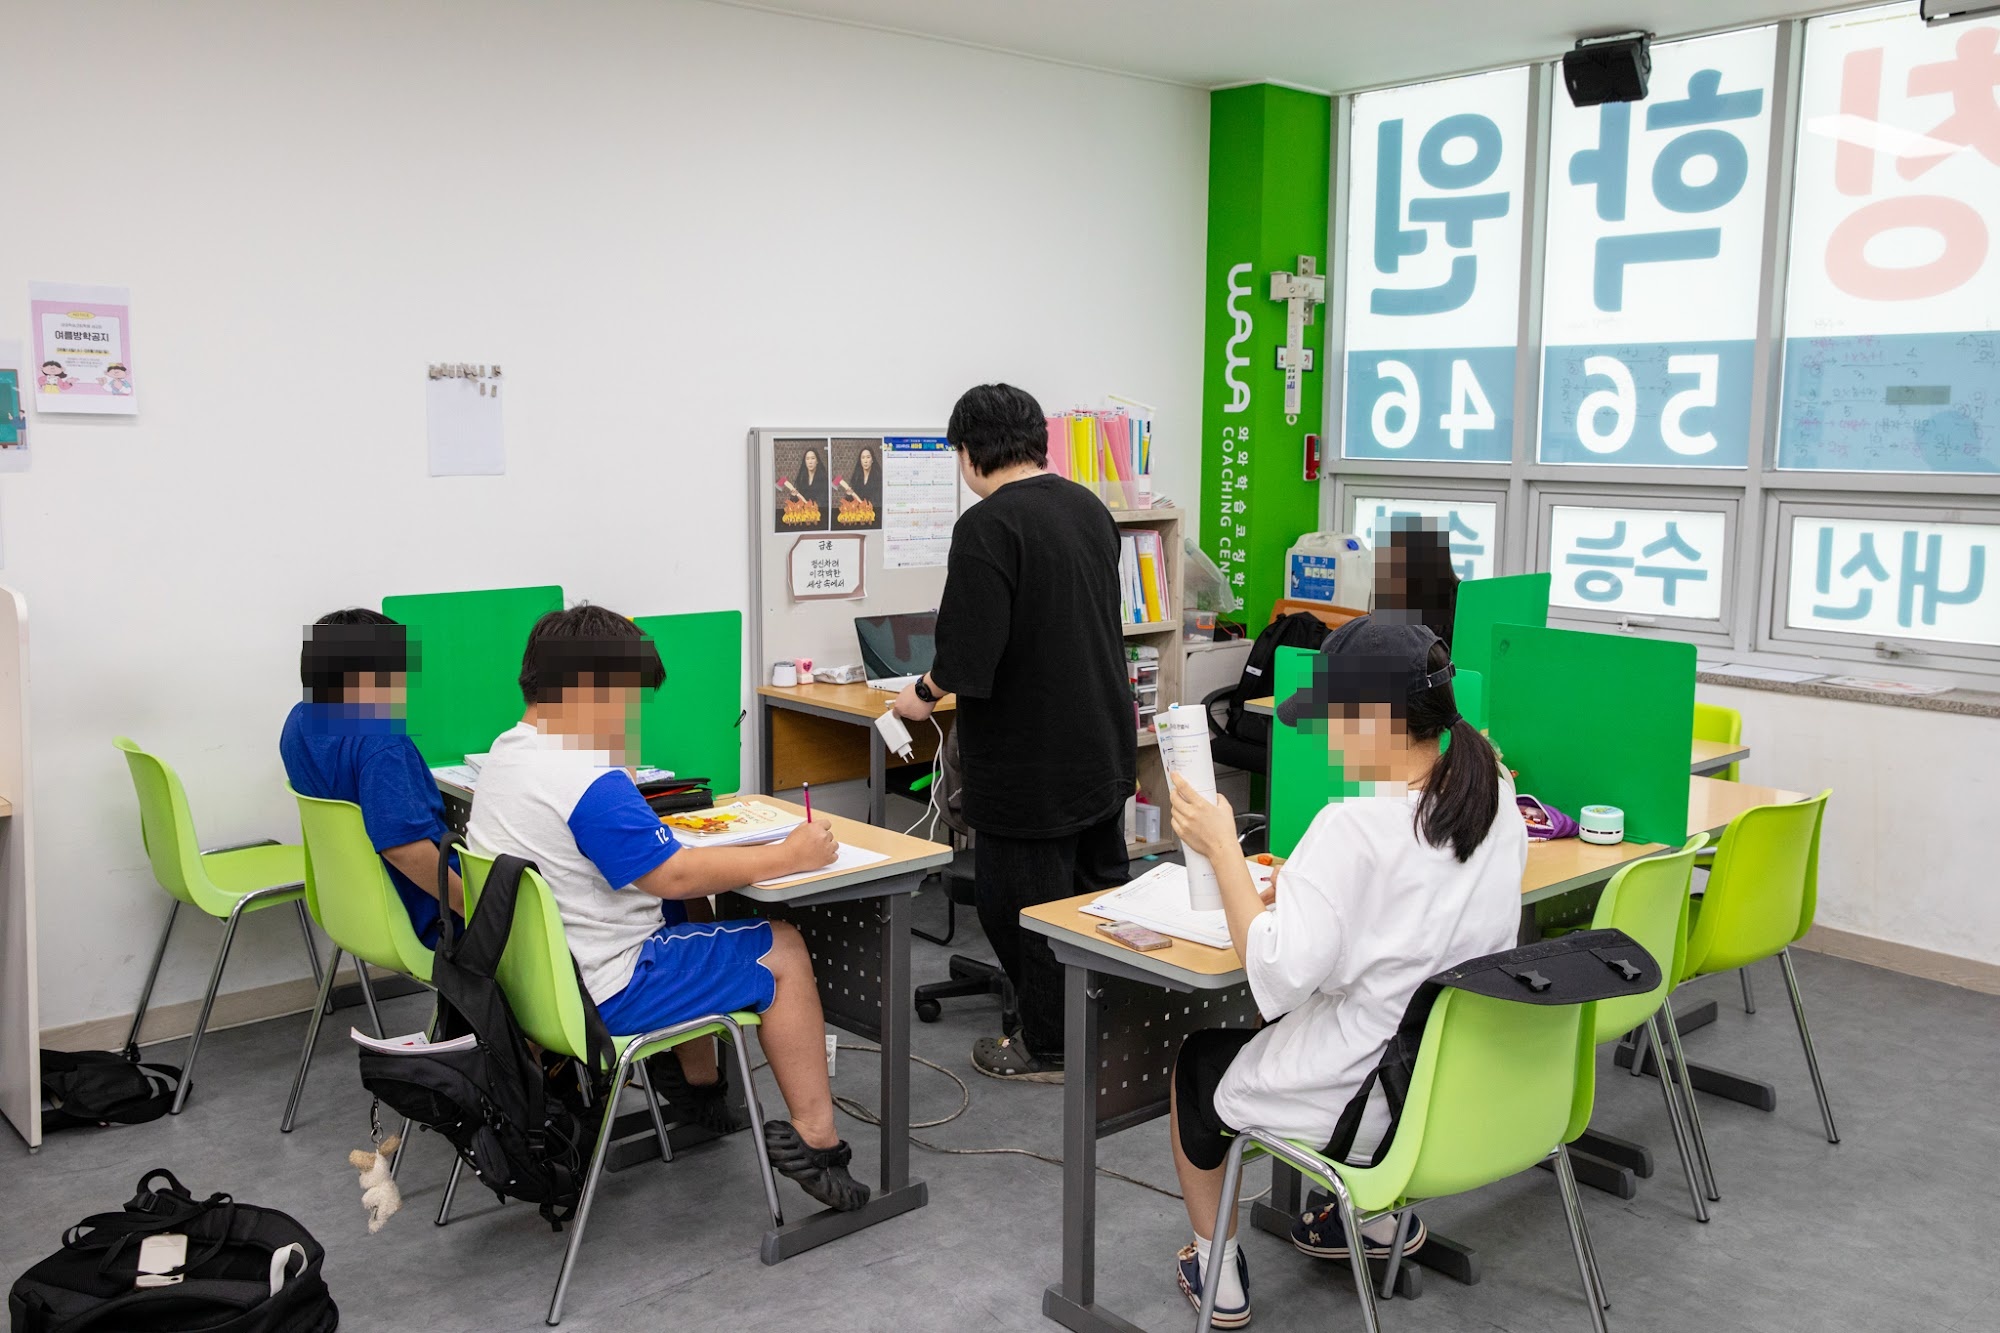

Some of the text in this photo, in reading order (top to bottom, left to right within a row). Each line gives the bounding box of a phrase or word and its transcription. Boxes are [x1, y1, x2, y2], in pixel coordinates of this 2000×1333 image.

[54, 330, 110, 343] 여름방학공지
[1220, 426, 1234, 527] COACHING
[655, 826, 670, 845] 12
